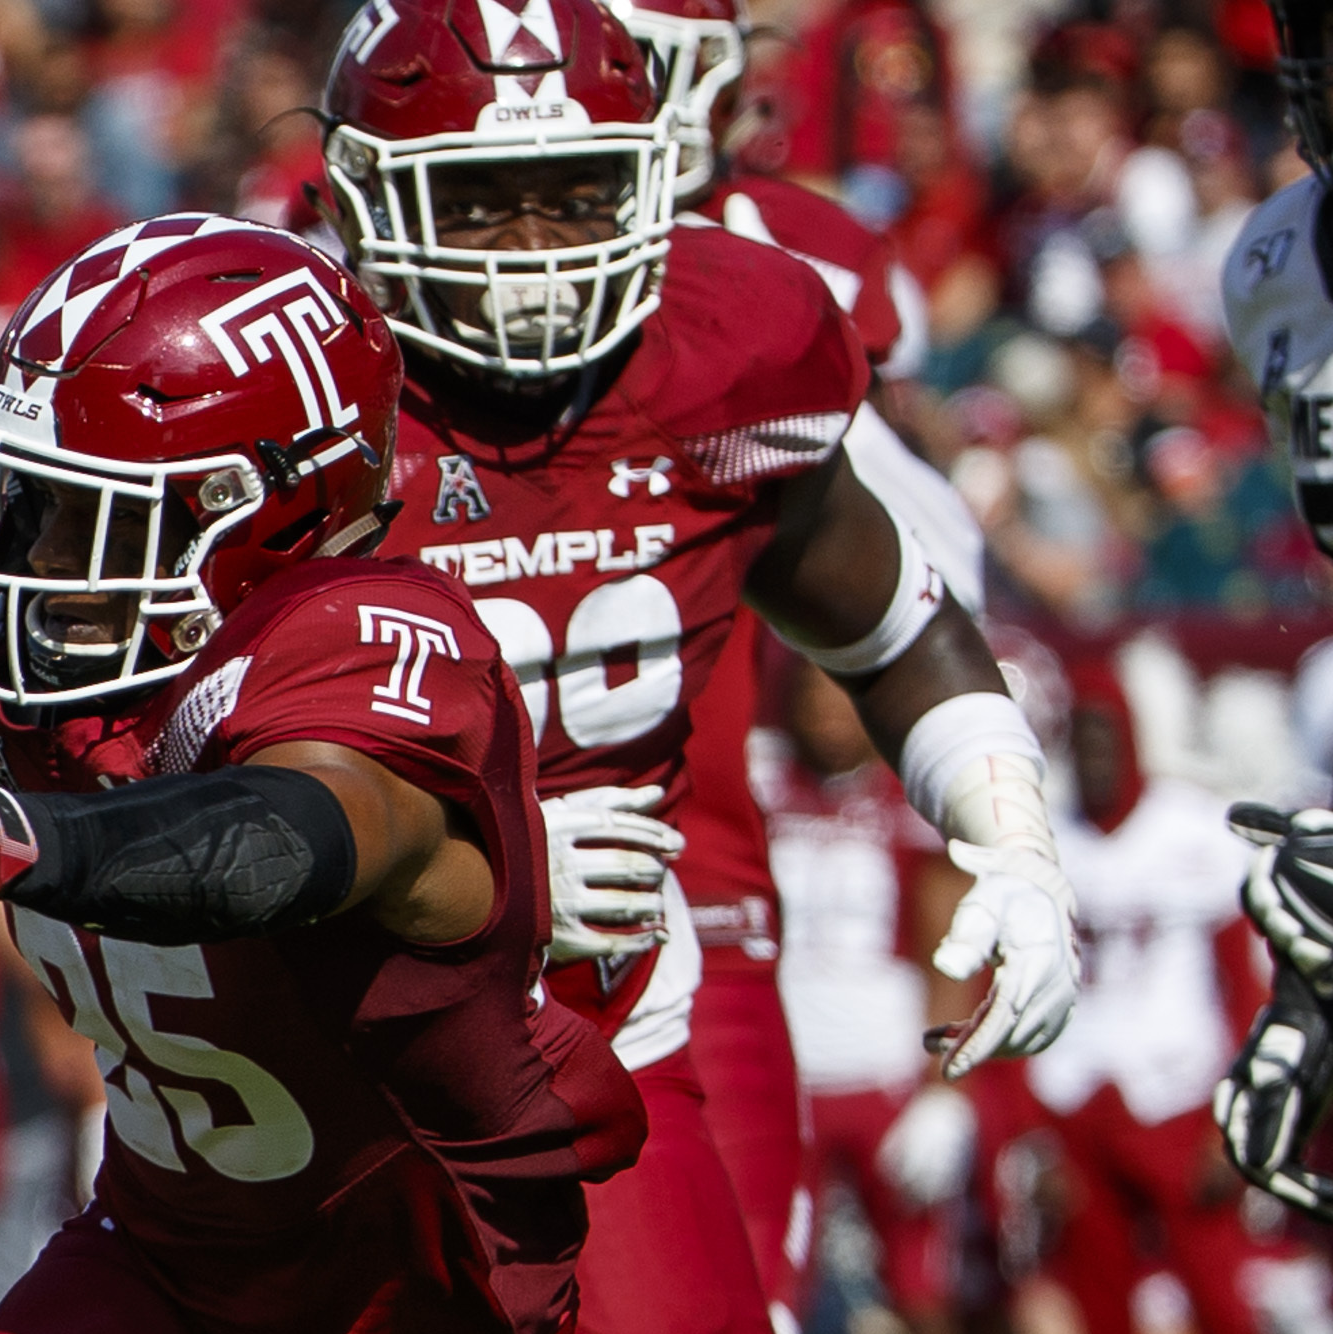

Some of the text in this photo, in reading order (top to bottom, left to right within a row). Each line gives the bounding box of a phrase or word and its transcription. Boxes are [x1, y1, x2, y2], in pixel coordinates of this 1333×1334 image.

[495, 103, 564, 122] OWLS
[434, 454, 490, 524] A
[420, 523, 675, 586] TEMPLE
